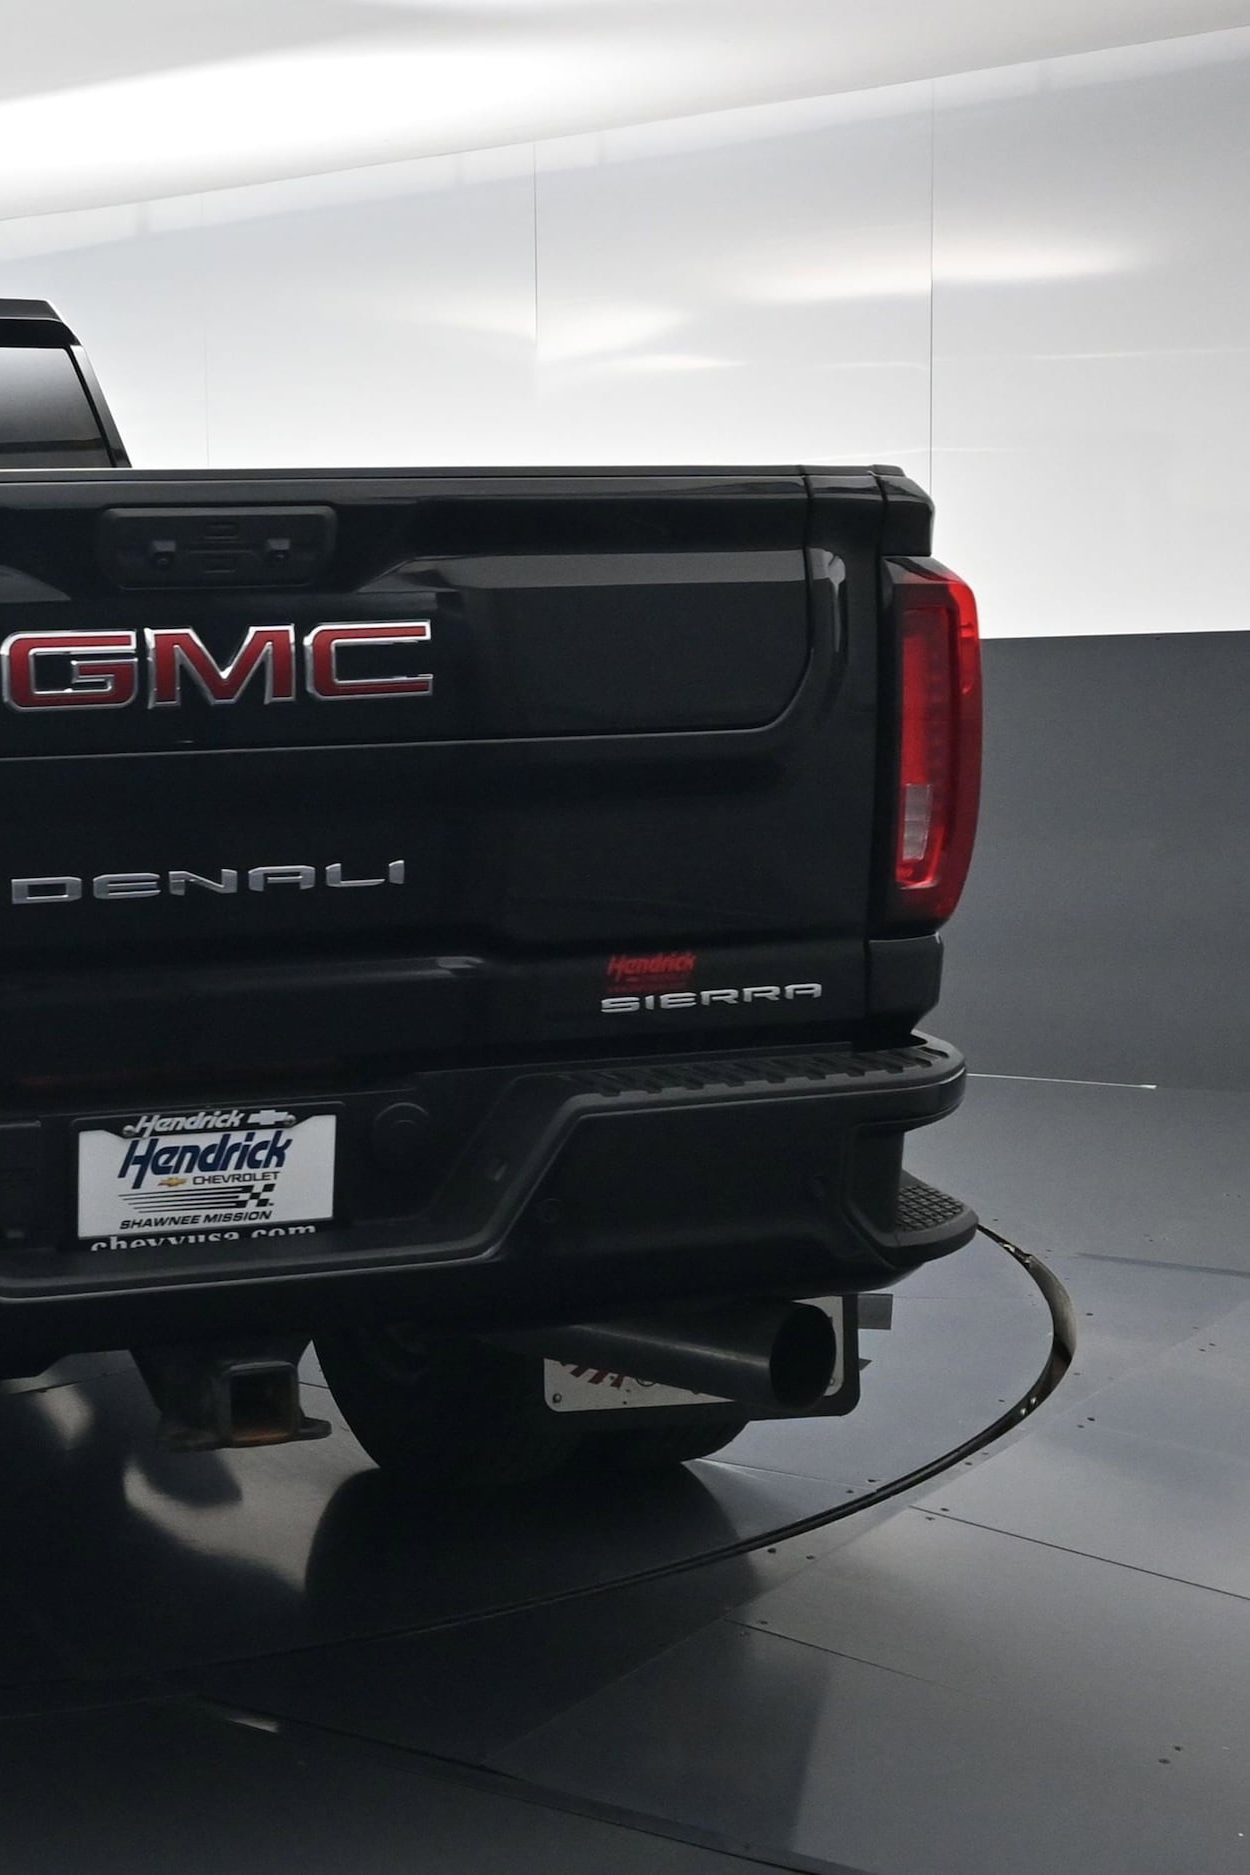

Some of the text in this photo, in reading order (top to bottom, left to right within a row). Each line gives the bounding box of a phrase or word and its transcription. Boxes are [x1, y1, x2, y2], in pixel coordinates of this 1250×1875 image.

[0, 620, 434, 712] GMC
[10, 859, 405, 904] DENALI
[607, 952, 697, 981] Hendrick
[600, 983, 822, 1013] SIERRA
[135, 1110, 245, 1137] Hendrick
[118, 1131, 293, 1189] Hendrick
[193, 1171, 280, 1185] CHEVROLET
[120, 1211, 272, 1230] SHAWNEE MISSION
